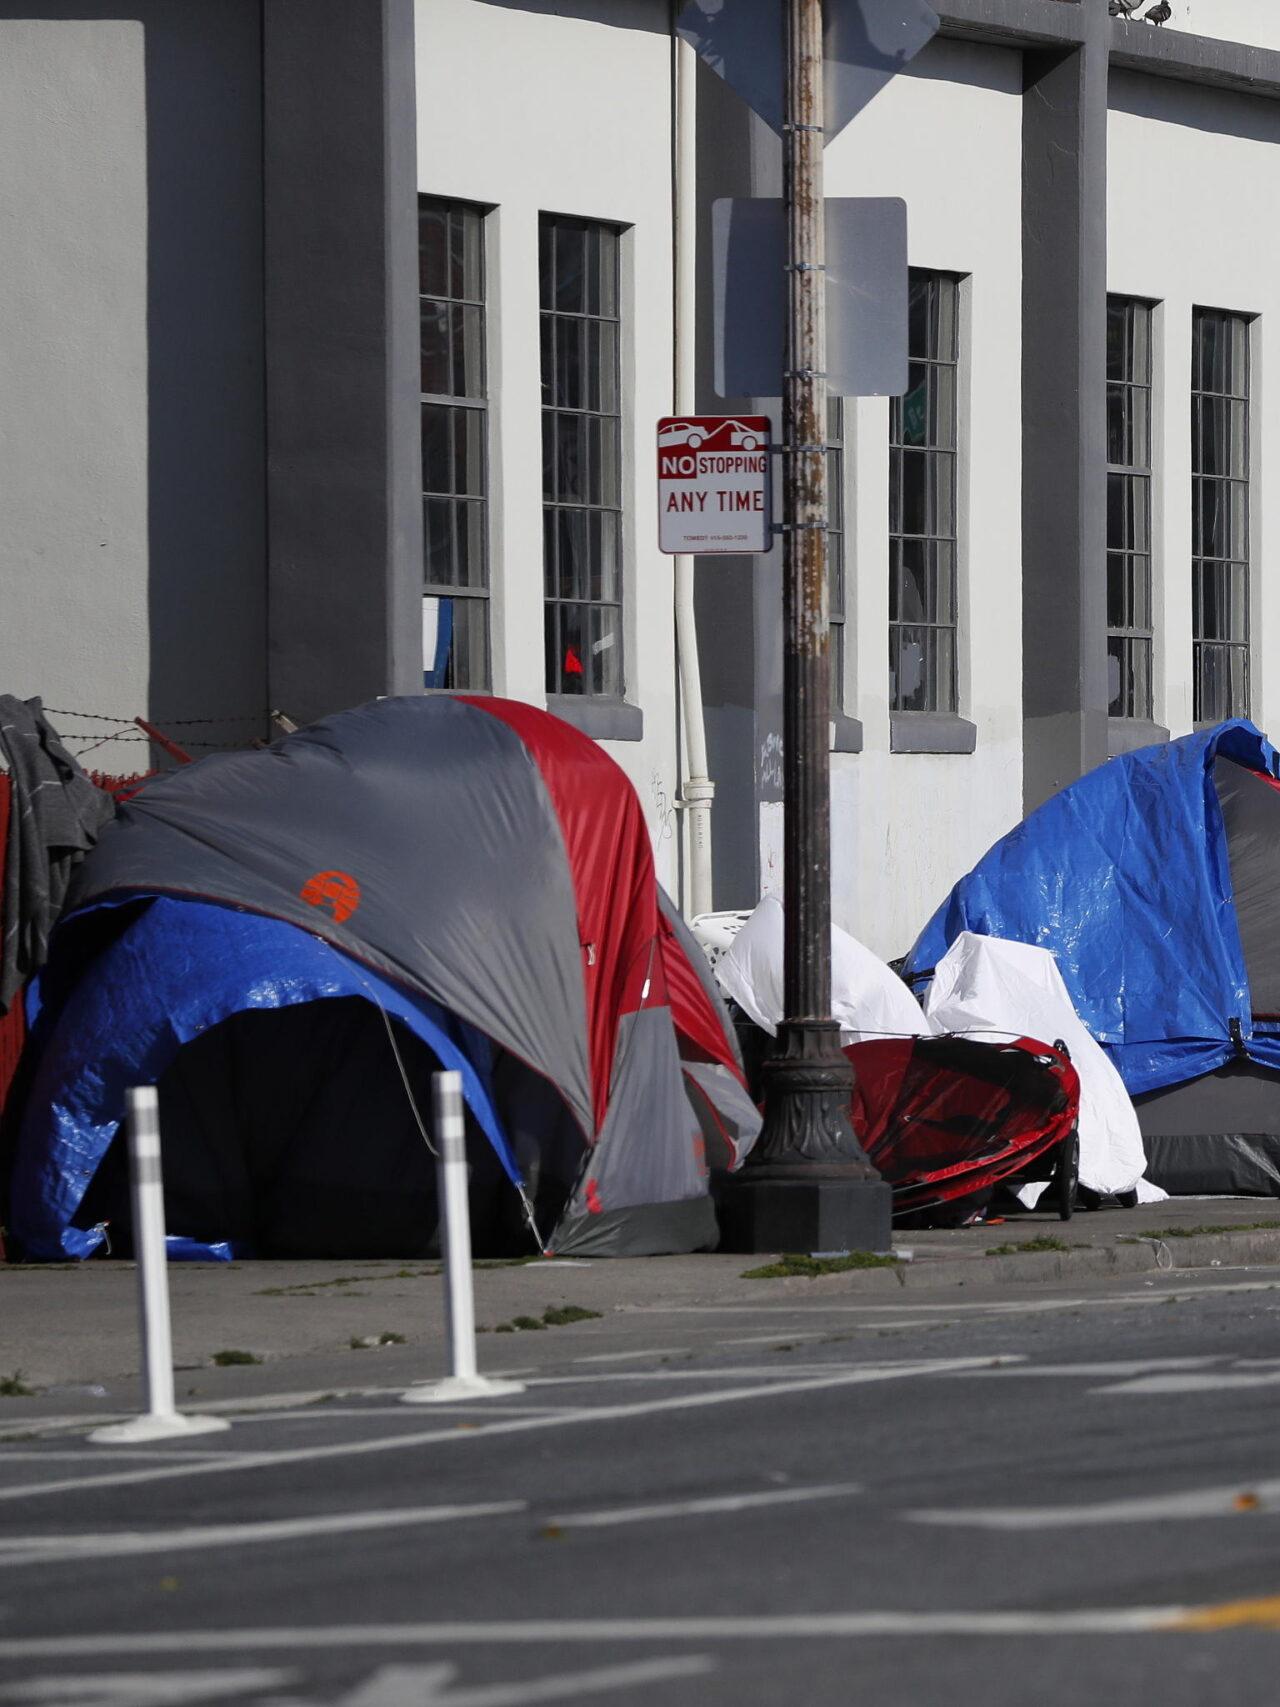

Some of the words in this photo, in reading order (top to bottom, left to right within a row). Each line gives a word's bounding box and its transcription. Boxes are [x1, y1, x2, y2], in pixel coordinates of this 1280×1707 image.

[662, 456, 695, 475] NO
[700, 456, 767, 474] STOPPING
[666, 491, 708, 512] ANY
[716, 490, 764, 512] TIME
